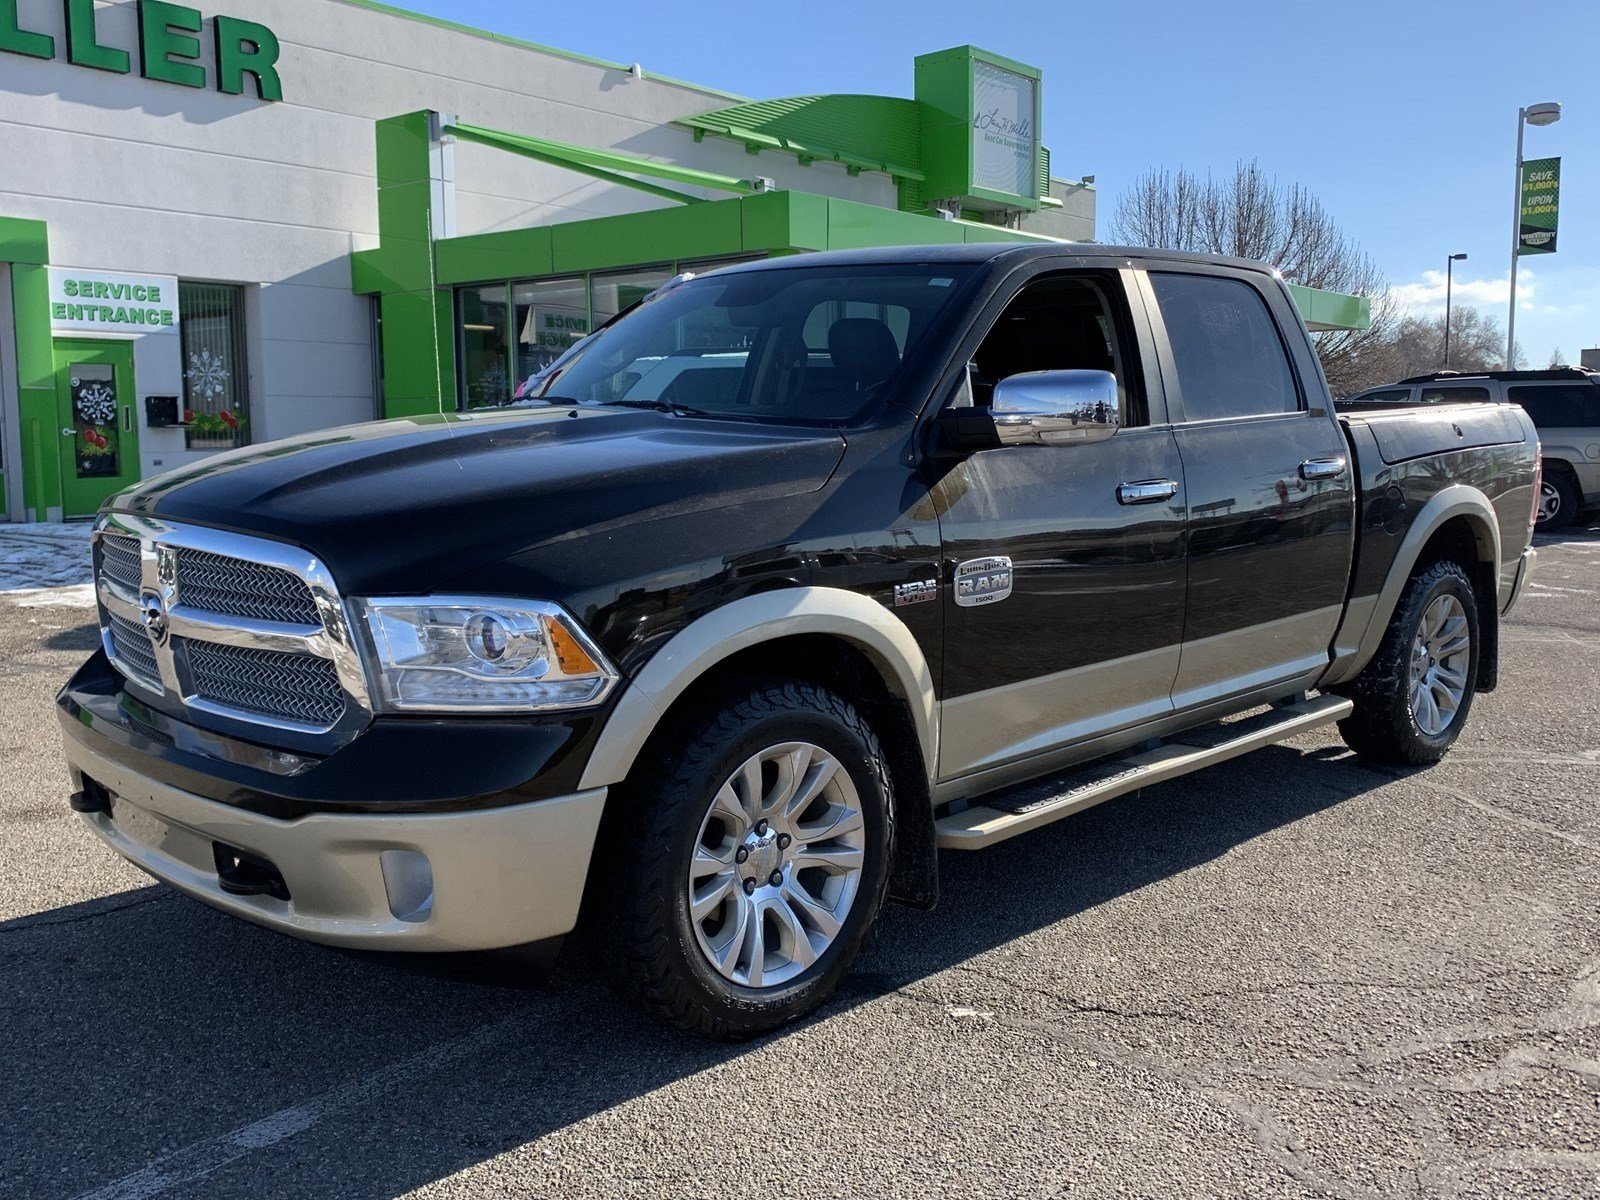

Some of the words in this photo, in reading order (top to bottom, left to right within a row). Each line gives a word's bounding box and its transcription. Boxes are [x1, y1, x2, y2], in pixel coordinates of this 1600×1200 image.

[0, 0, 283, 101] LLER
[1529, 170, 1554, 182] SAVE
[1523, 181, 1558, 191] $1,000's
[1527, 195, 1554, 206] UPON
[1522, 205, 1557, 215] $1,000's
[63, 279, 161, 303] SERVICE
[52, 302, 174, 326] ENTRANCE
[959, 573, 1009, 593] RAM
[975, 595, 993, 603] 1500
